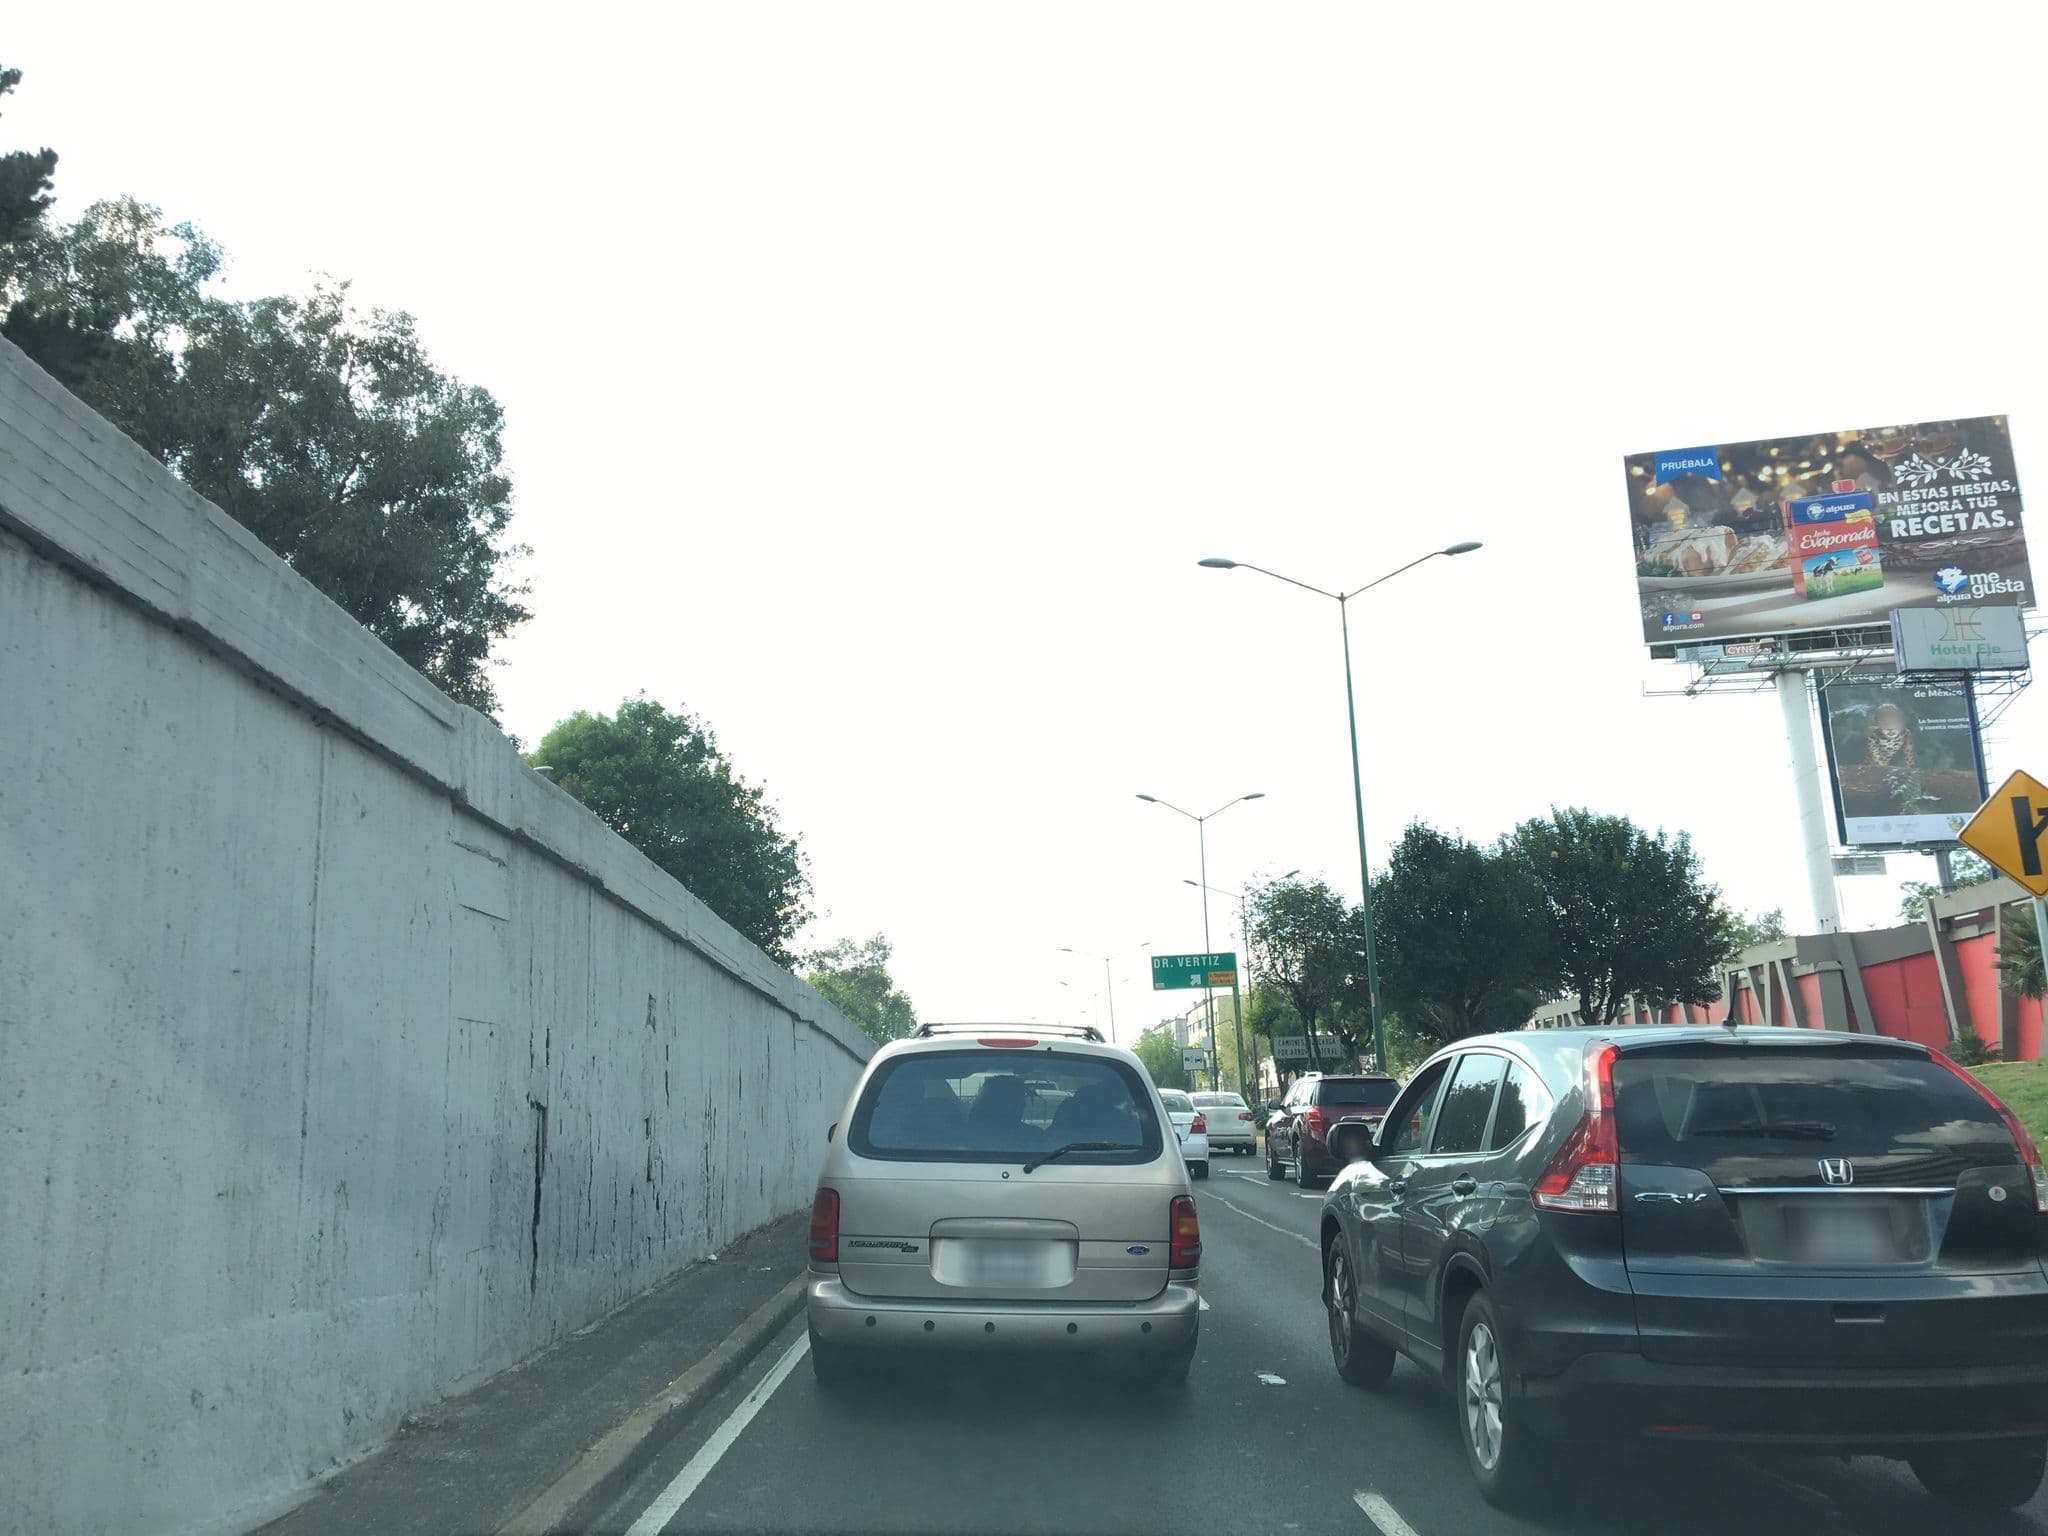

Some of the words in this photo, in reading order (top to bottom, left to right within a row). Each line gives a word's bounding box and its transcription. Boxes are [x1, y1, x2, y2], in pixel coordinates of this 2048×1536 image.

[1661, 458, 1714, 471] PRUÉBALA
[1877, 491, 1899, 504] EN
[1902, 487, 1949, 501] ESTAS
[1952, 480, 2017, 497] FIESTAS,
[1896, 499, 1963, 516] MEJORA
[1967, 495, 1998, 509] TUS
[1890, 509, 2015, 538] RECETAS.
[1800, 527, 1876, 549] Evaporada
[1969, 572, 2000, 585] me
[1971, 578, 2025, 599] gusta
[1936, 593, 1971, 603] alpura
[1662, 622, 1705, 632] alpura.com
[1930, 644, 1972, 655] Hotel
[1976, 643, 2001, 656] Eje
[1153, 958, 1174, 969] DR.
[1177, 955, 1220, 967] VERTIZ
